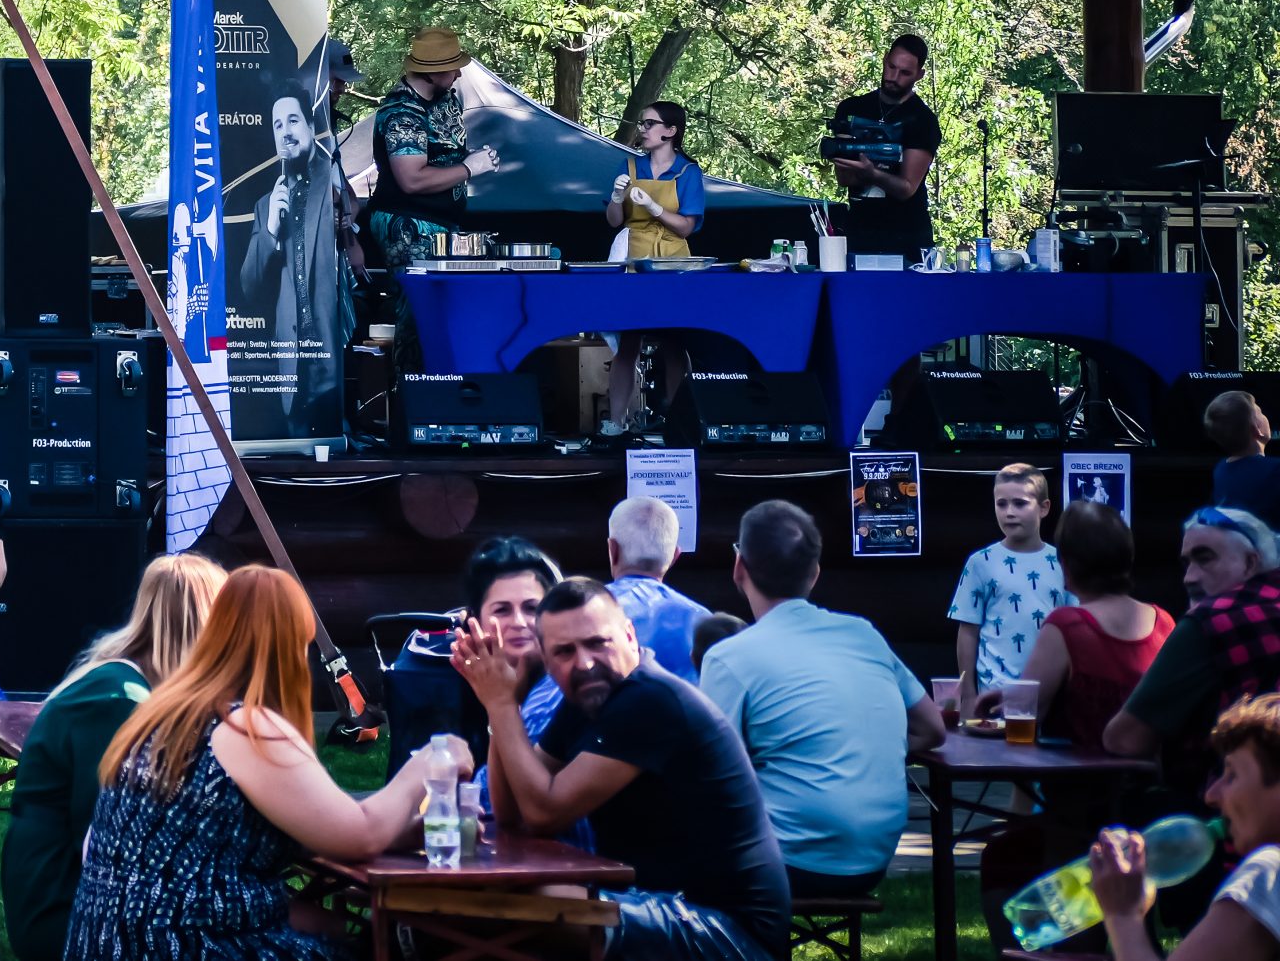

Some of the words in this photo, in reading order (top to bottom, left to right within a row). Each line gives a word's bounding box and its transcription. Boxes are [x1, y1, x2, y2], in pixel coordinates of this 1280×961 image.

[216, 60, 260, 69] DERÁTOR
[218, 111, 262, 125] ERÁTOR
[194, 111, 216, 193] VITA
[225, 314, 265, 329] ottrem
[226, 341, 246, 349] estivaly
[228, 375, 298, 383] AREKFOTTR_MODERATOR
[1093, 462, 1124, 471] BŘEZNO
[863, 472, 889, 480] 9.9.2023
